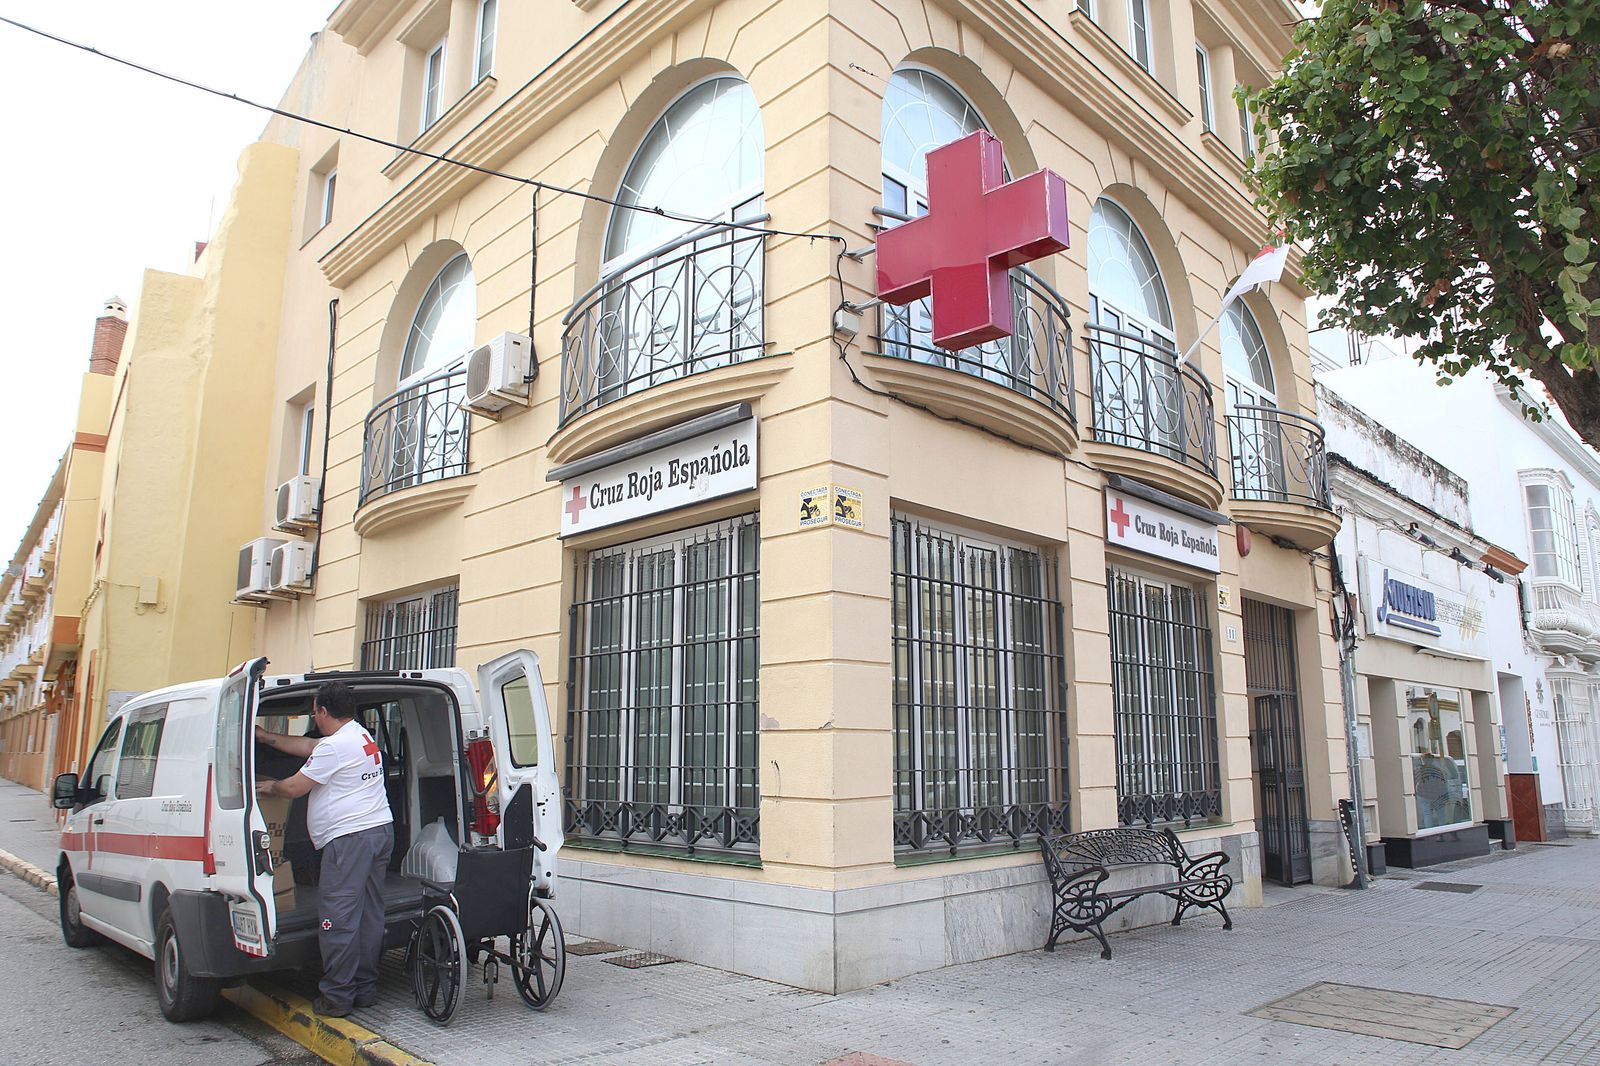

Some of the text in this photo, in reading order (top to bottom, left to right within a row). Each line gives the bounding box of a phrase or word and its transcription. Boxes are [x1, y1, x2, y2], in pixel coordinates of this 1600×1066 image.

[589, 439, 751, 510] Cruz Roja Española
[800, 486, 828, 498] CONECTADA
[834, 486, 862, 498] CONECTADA
[800, 515, 828, 526] PROSEGUR
[834, 516, 862, 527] PROSEGUR
[1134, 514, 1218, 557] Cruz Roja Española
[361, 770, 378, 781] Cruz
